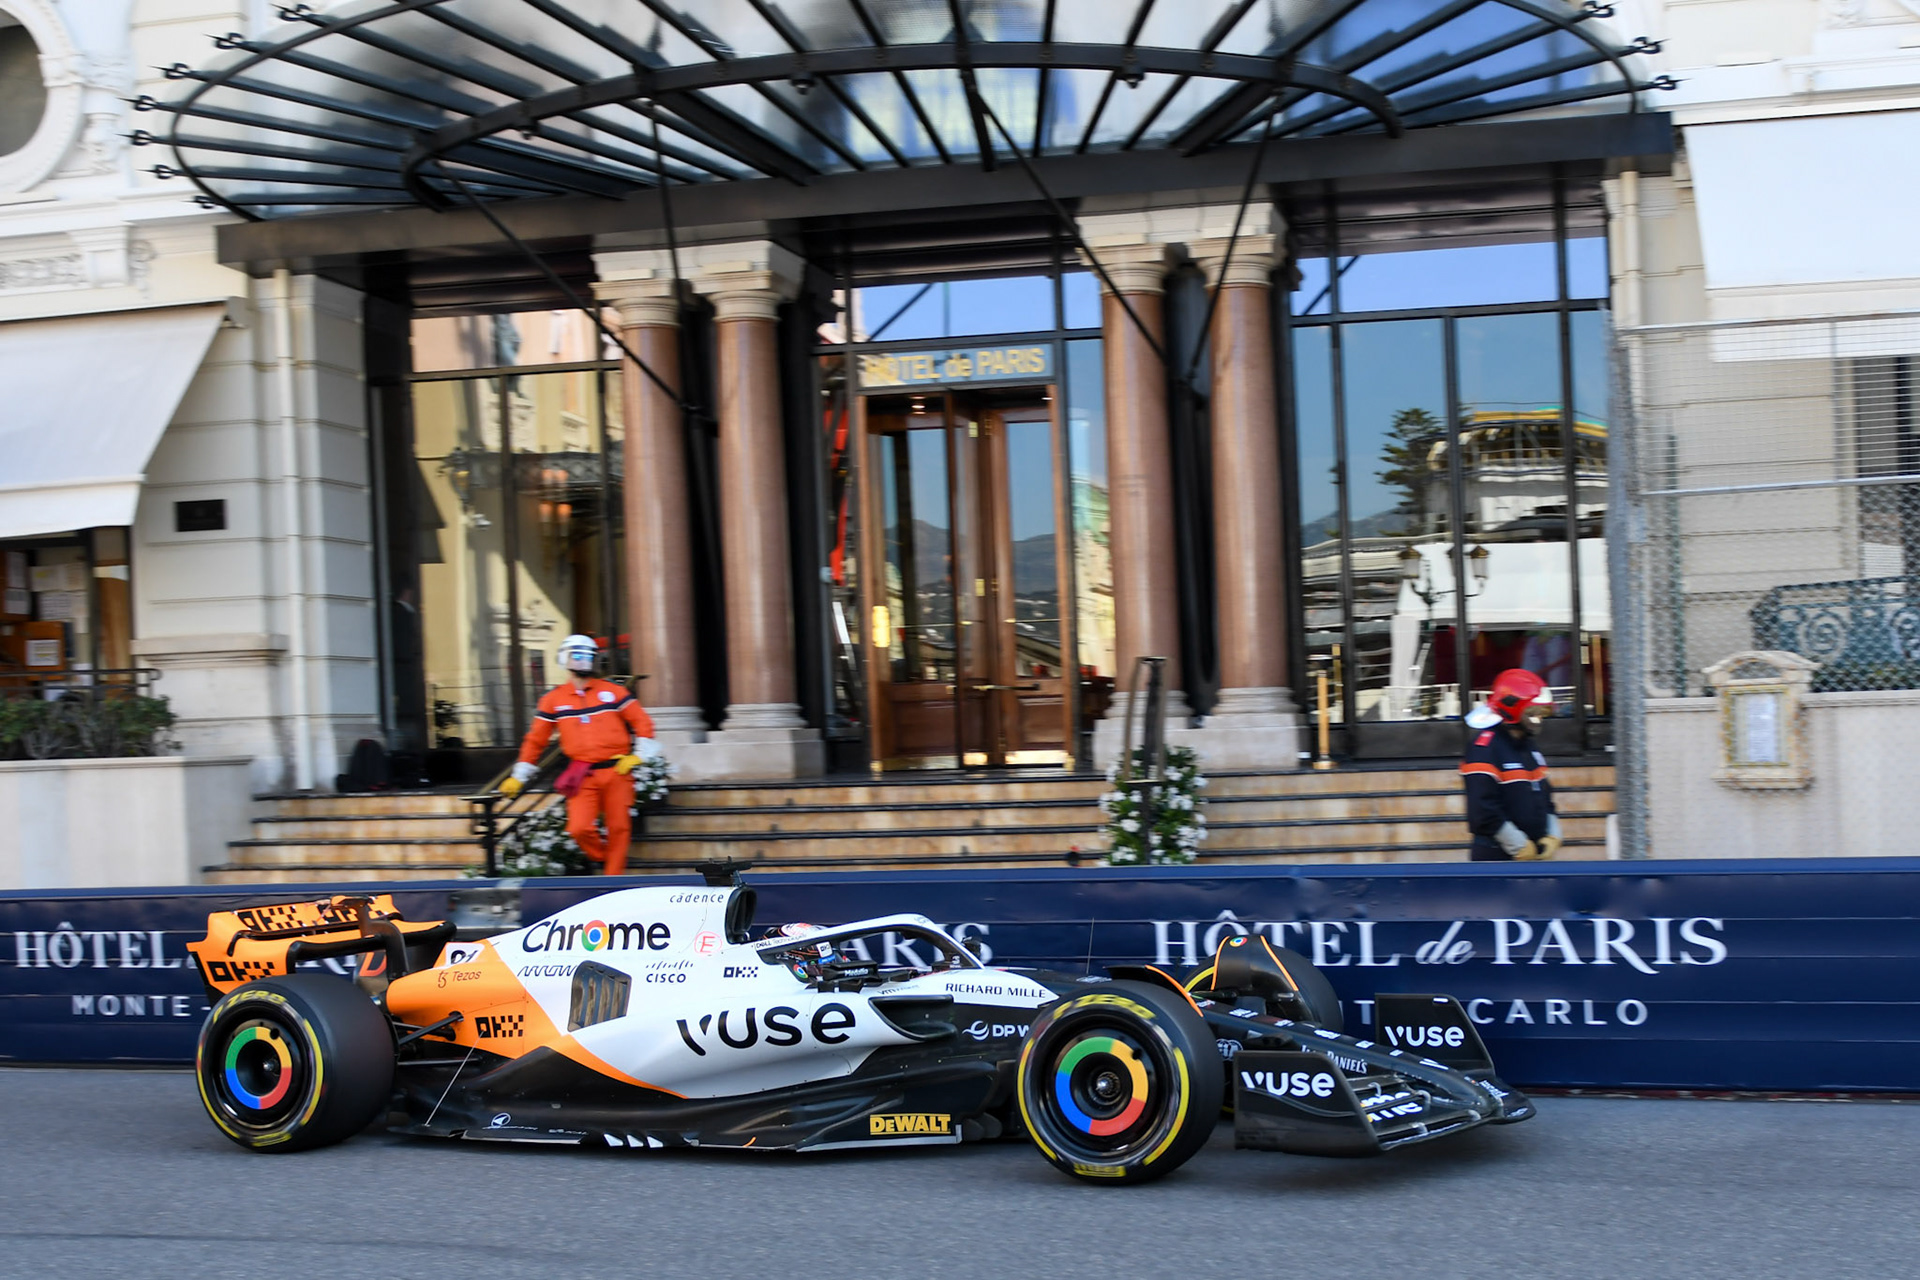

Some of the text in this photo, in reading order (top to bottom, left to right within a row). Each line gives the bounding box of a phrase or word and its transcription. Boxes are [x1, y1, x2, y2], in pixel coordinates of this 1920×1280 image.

[977, 347, 1045, 376] PARIS
[669, 893, 725, 904] cadence
[14, 920, 183, 969] HÔTEL
[521, 919, 671, 953] Chrome
[1151, 909, 1729, 975] HÔTEL de PARIS
[452, 970, 482, 983] Tezos
[645, 973, 687, 984] CISCO
[945, 983, 1047, 999] RICHARD MILLE
[72, 994, 192, 1017] MONTE
[1466, 998, 1649, 1026] CARLO
[992, 1024, 1017, 1038] DP
